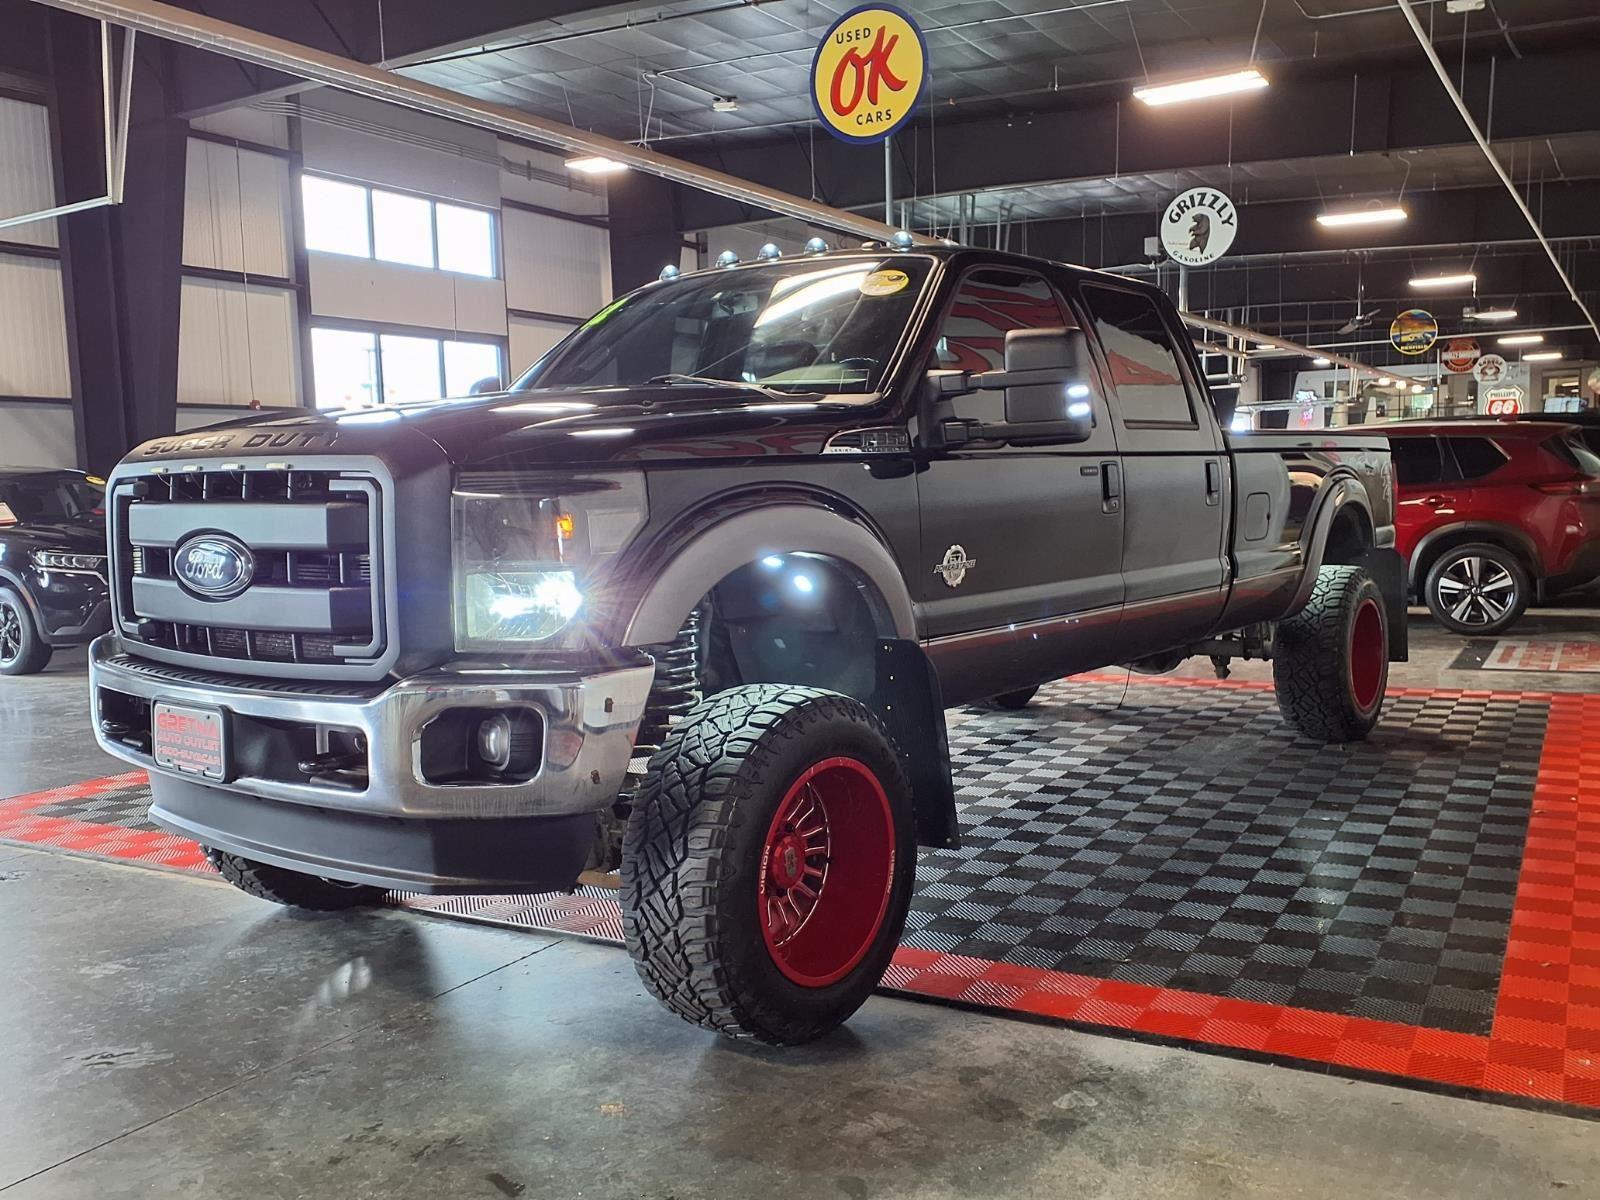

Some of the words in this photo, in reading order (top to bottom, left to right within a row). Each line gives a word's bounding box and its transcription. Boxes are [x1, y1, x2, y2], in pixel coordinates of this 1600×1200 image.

[836, 27, 871, 44] USED
[830, 25, 909, 117] OK
[856, 109, 892, 125] CARS
[1168, 192, 1234, 227] GRIZZLY
[1173, 250, 1215, 263] GASOLINE
[1490, 399, 1515, 415] 66
[143, 434, 236, 456] SUPER
[242, 431, 339, 449] DUTY
[184, 548, 226, 580] Ford
